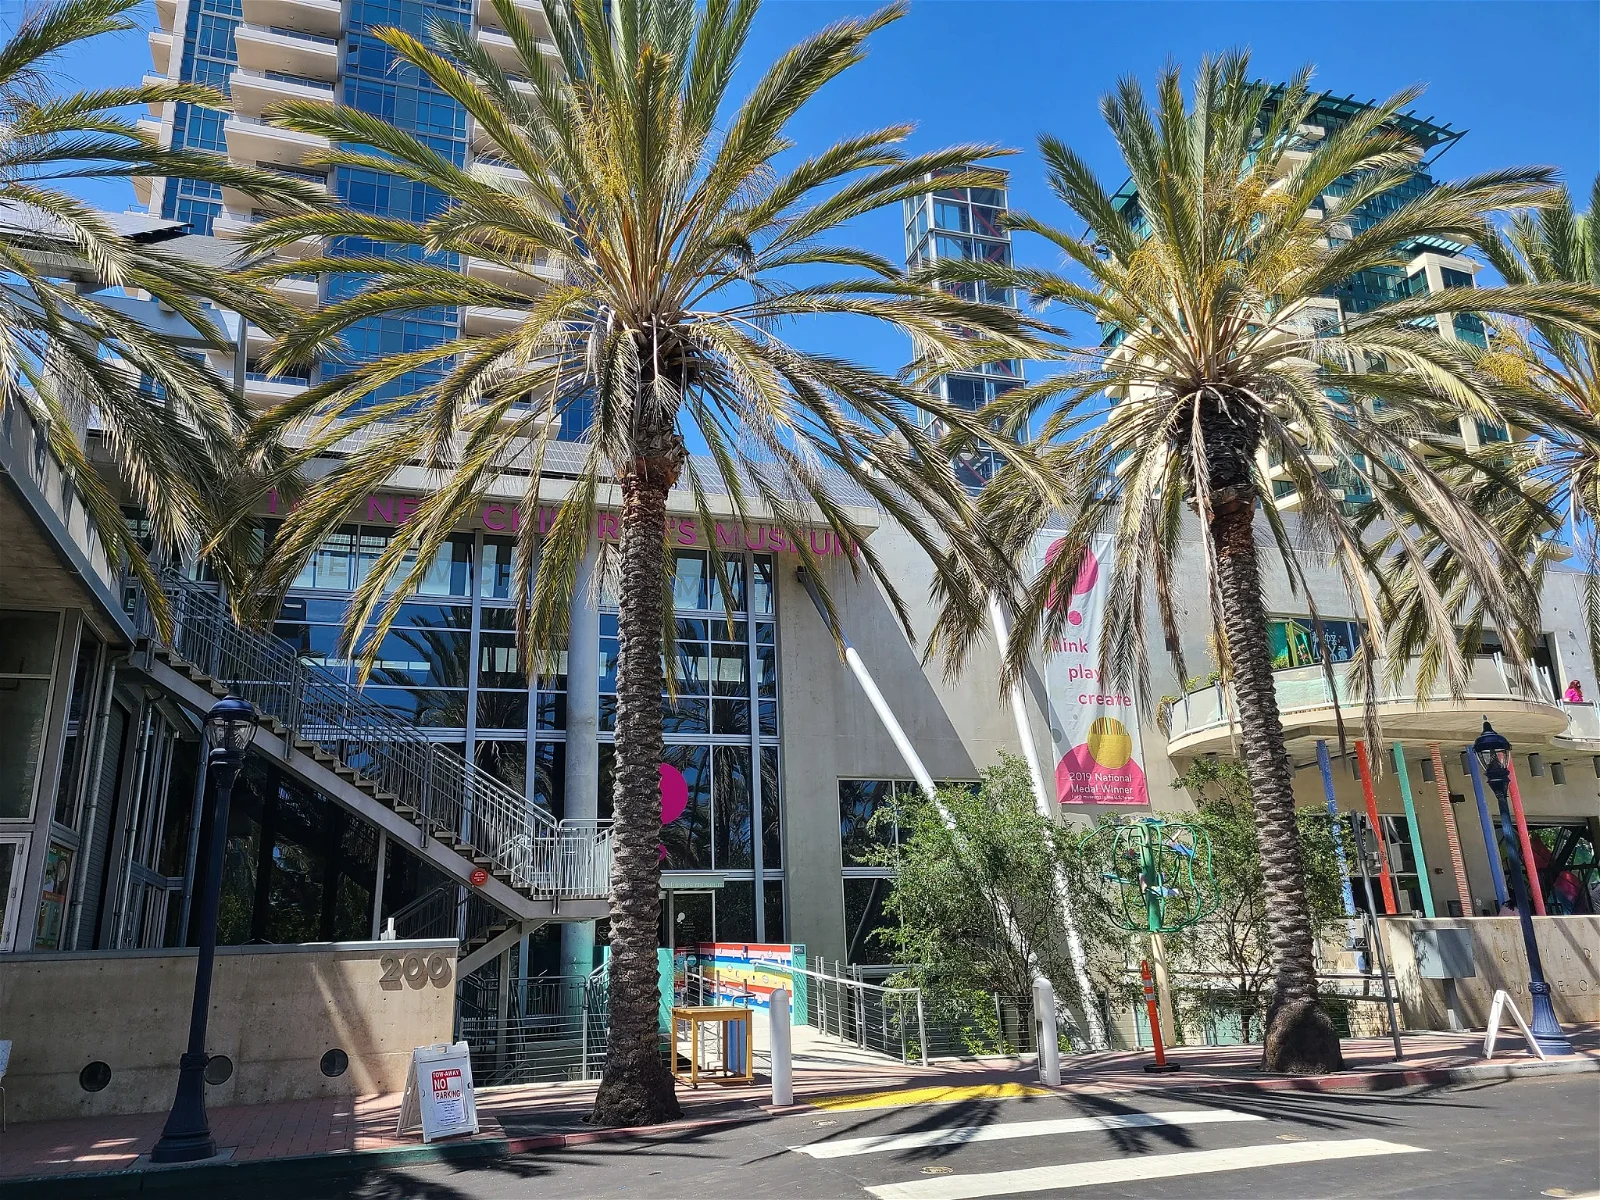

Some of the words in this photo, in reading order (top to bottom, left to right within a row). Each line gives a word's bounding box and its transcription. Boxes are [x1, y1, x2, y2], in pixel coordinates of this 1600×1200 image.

[1049, 637, 1090, 654] hink
[1078, 693, 1132, 707] create
[1069, 772, 1092, 781] 2019
[1095, 773, 1132, 783] National
[1071, 783, 1098, 793] Medal
[1101, 784, 1133, 794] Winner
[379, 952, 452, 990] 200
[432, 1070, 460, 1078] TOW-AWAY
[433, 1078, 446, 1090] NO
[435, 1089, 461, 1100] PARKING
